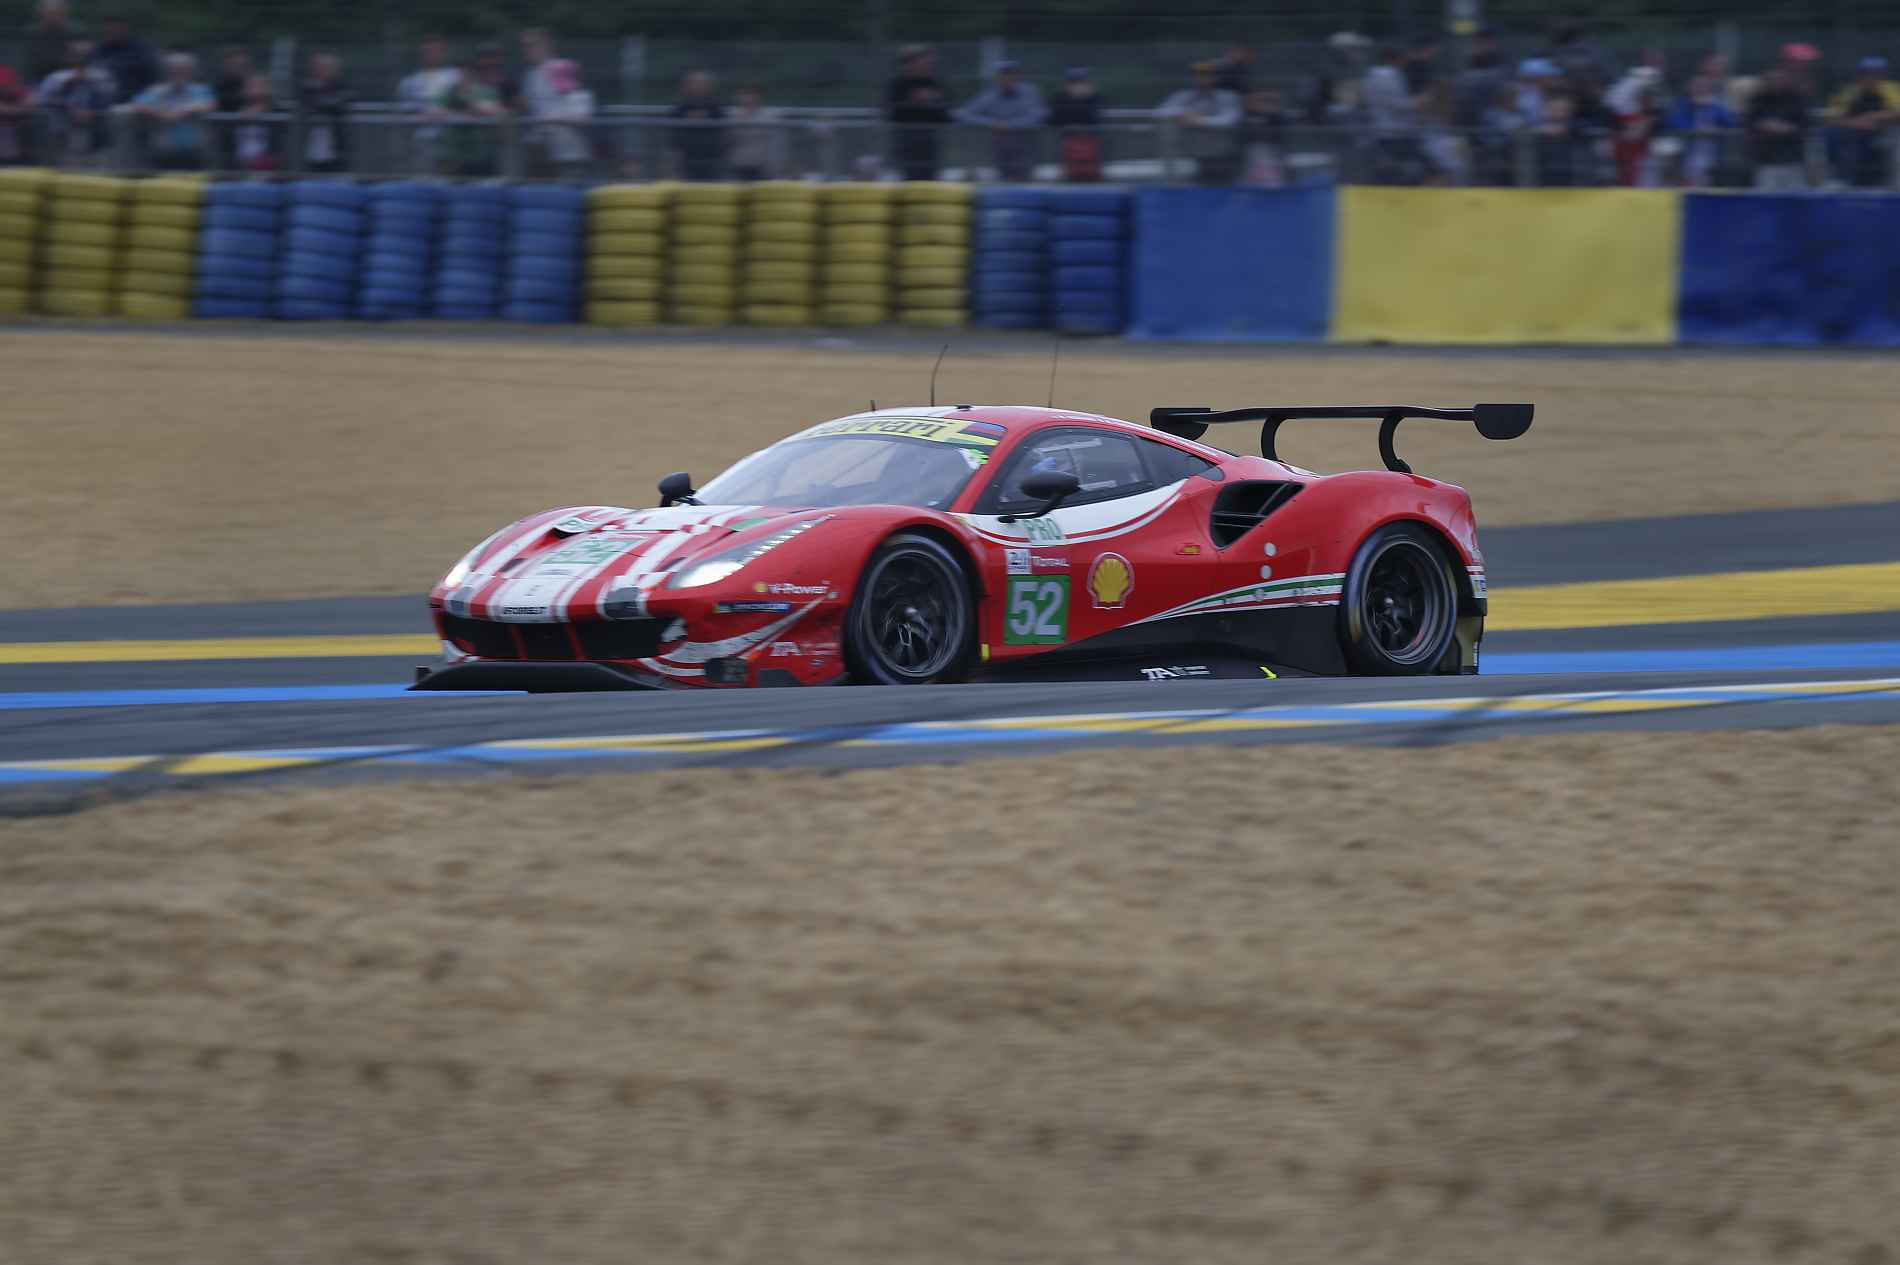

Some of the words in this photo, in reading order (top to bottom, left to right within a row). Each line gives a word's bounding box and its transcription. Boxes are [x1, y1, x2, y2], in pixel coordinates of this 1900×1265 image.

[804, 419, 947, 438] errari
[1024, 517, 1062, 541] PRO
[1010, 581, 1063, 636] 52
